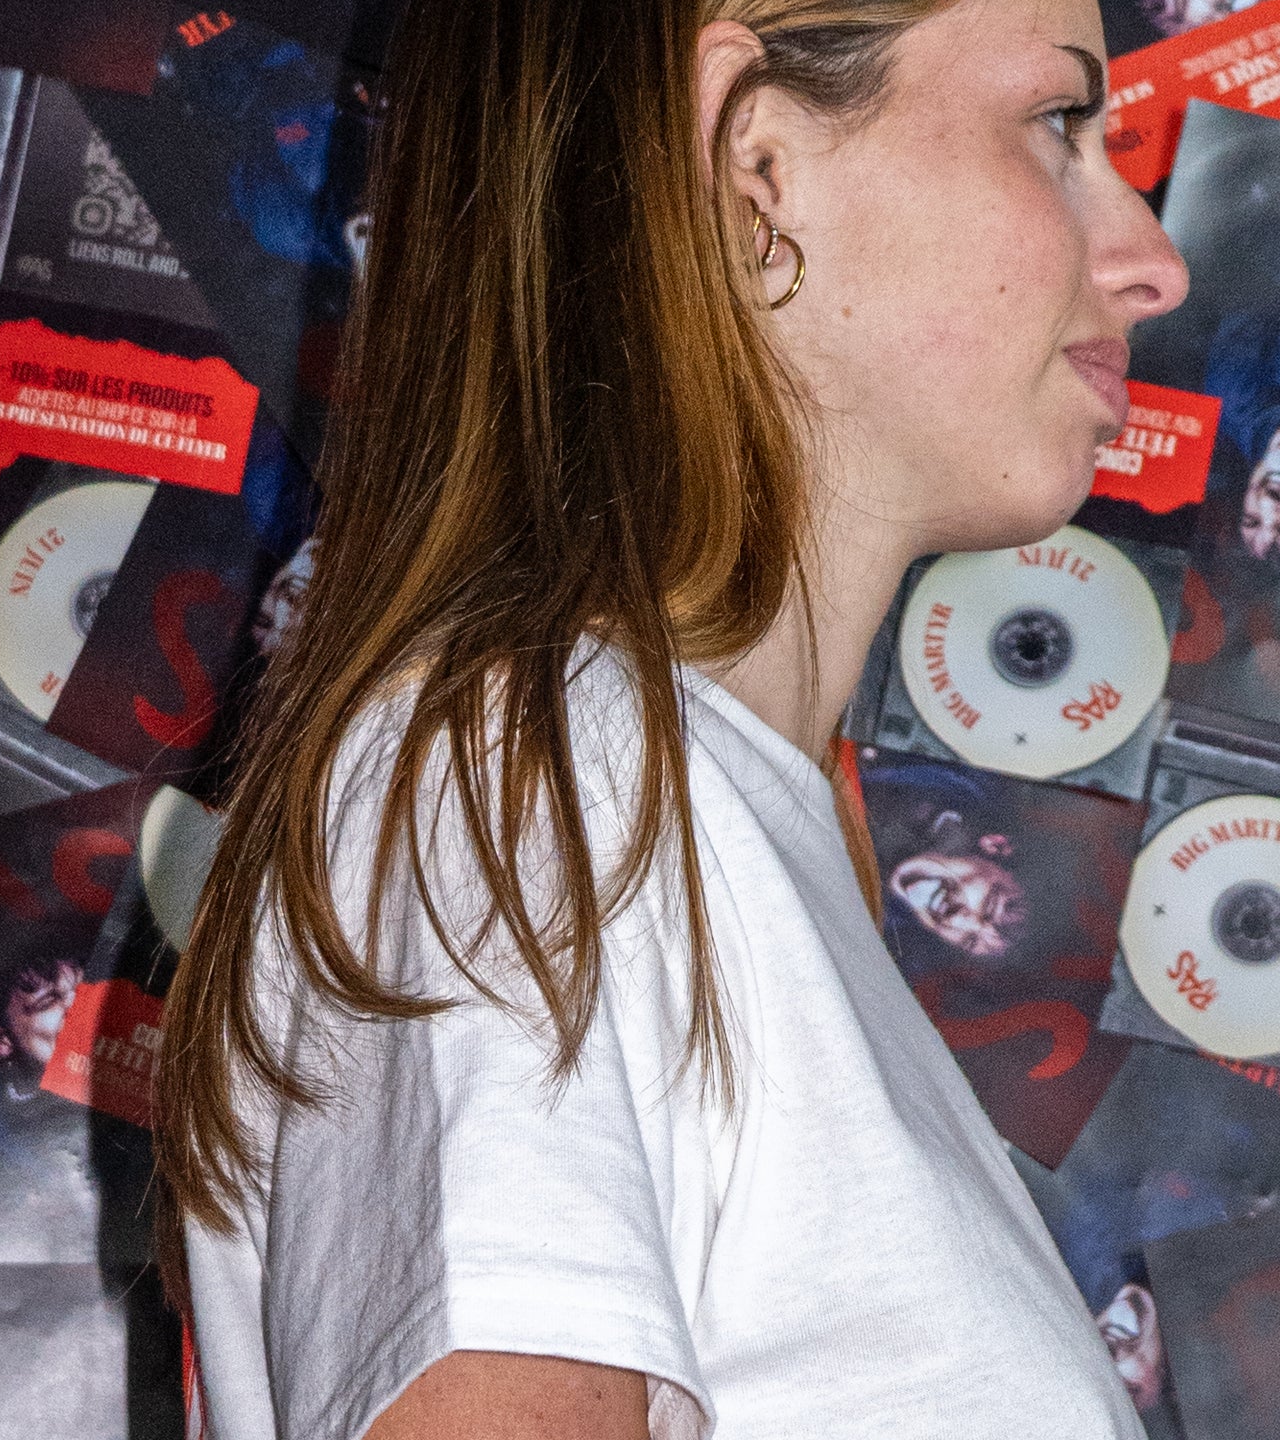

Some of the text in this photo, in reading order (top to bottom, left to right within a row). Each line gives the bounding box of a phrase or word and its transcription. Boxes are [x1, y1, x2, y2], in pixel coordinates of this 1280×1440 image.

[52, 366, 89, 393] SUR
[88, 373, 125, 401] LES
[125, 379, 216, 418] PRODUITS
[127, 425, 149, 447] DE
[150, 430, 174, 451] CE
[174, 435, 228, 462] FLYER
[1169, 838, 1210, 873] BIG
[1165, 949, 1218, 1014] RAS
